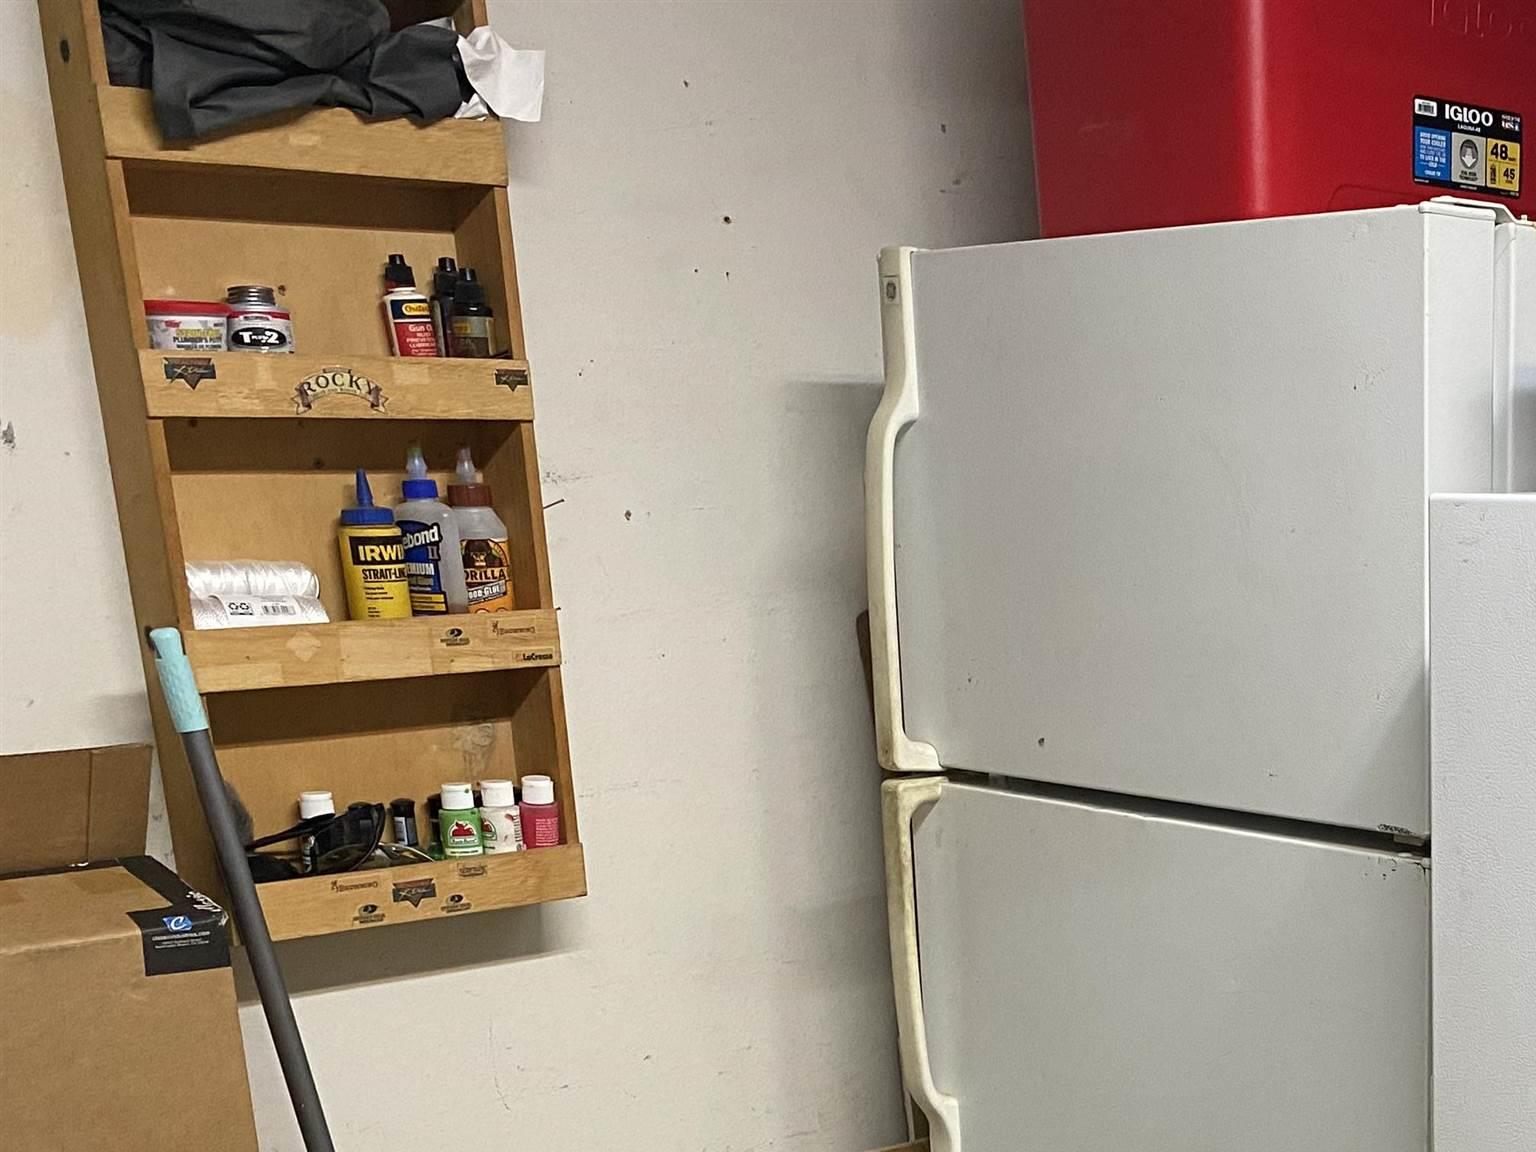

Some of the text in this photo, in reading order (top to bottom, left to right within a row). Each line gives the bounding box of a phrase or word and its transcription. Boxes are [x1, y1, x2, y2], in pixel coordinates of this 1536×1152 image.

[1444, 103, 1494, 127] IGLOO
[1490, 142, 1509, 160] 48
[1503, 167, 1516, 180] 45
[299, 372, 380, 396] ROCKY
[403, 525, 440, 550] ebond
[358, 544, 404, 561] IRWI
[464, 568, 506, 581] ORILLA
